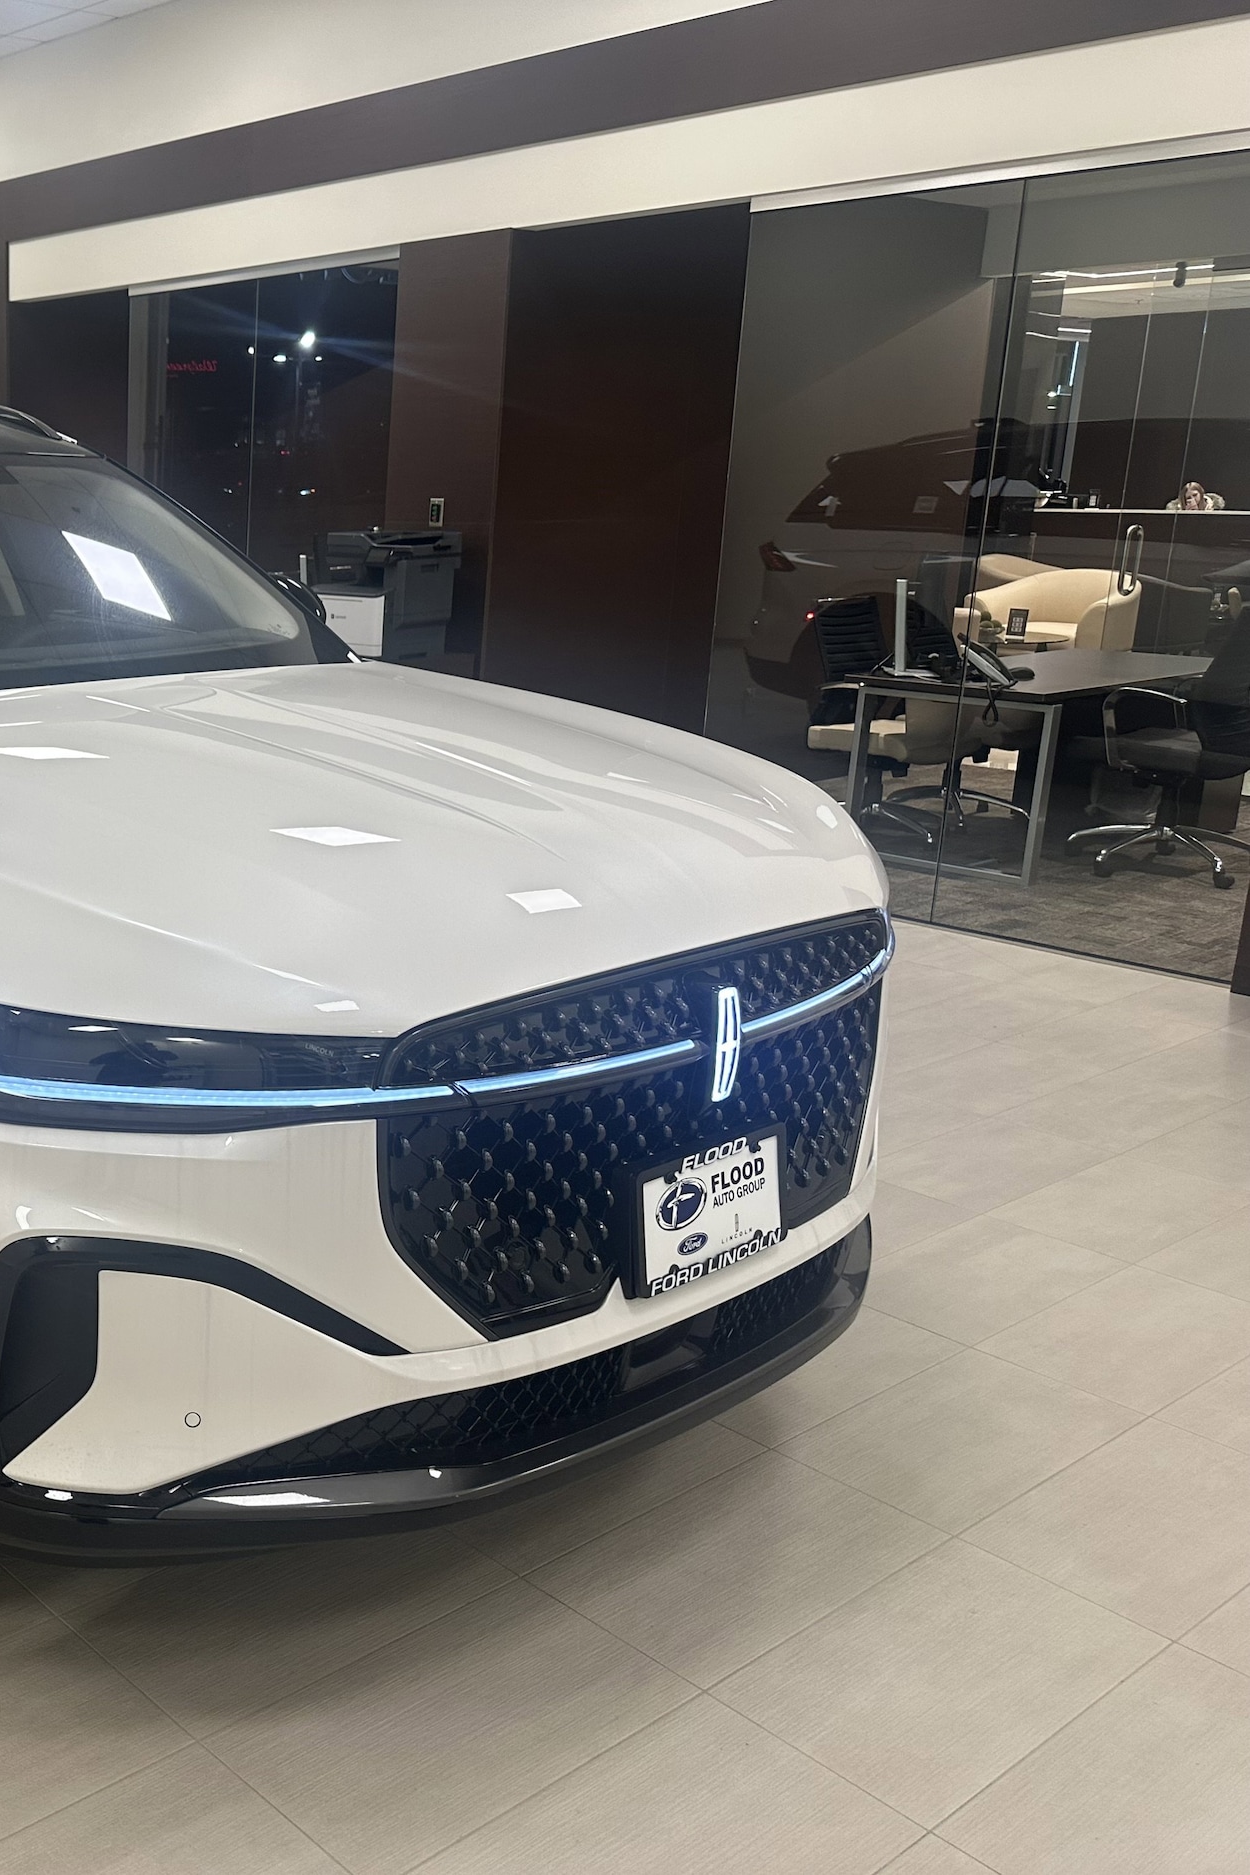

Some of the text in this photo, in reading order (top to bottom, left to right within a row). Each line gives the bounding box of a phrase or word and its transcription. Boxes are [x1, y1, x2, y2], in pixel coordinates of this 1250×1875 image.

[681, 1137, 747, 1172] FLOOD
[711, 1157, 765, 1193] FLOOD
[713, 1178, 766, 1208] AUTO GROUP
[682, 1236, 702, 1252] Ford
[721, 1227, 753, 1244] LINCOLN
[651, 1228, 782, 1296] FORD LINCOLN
